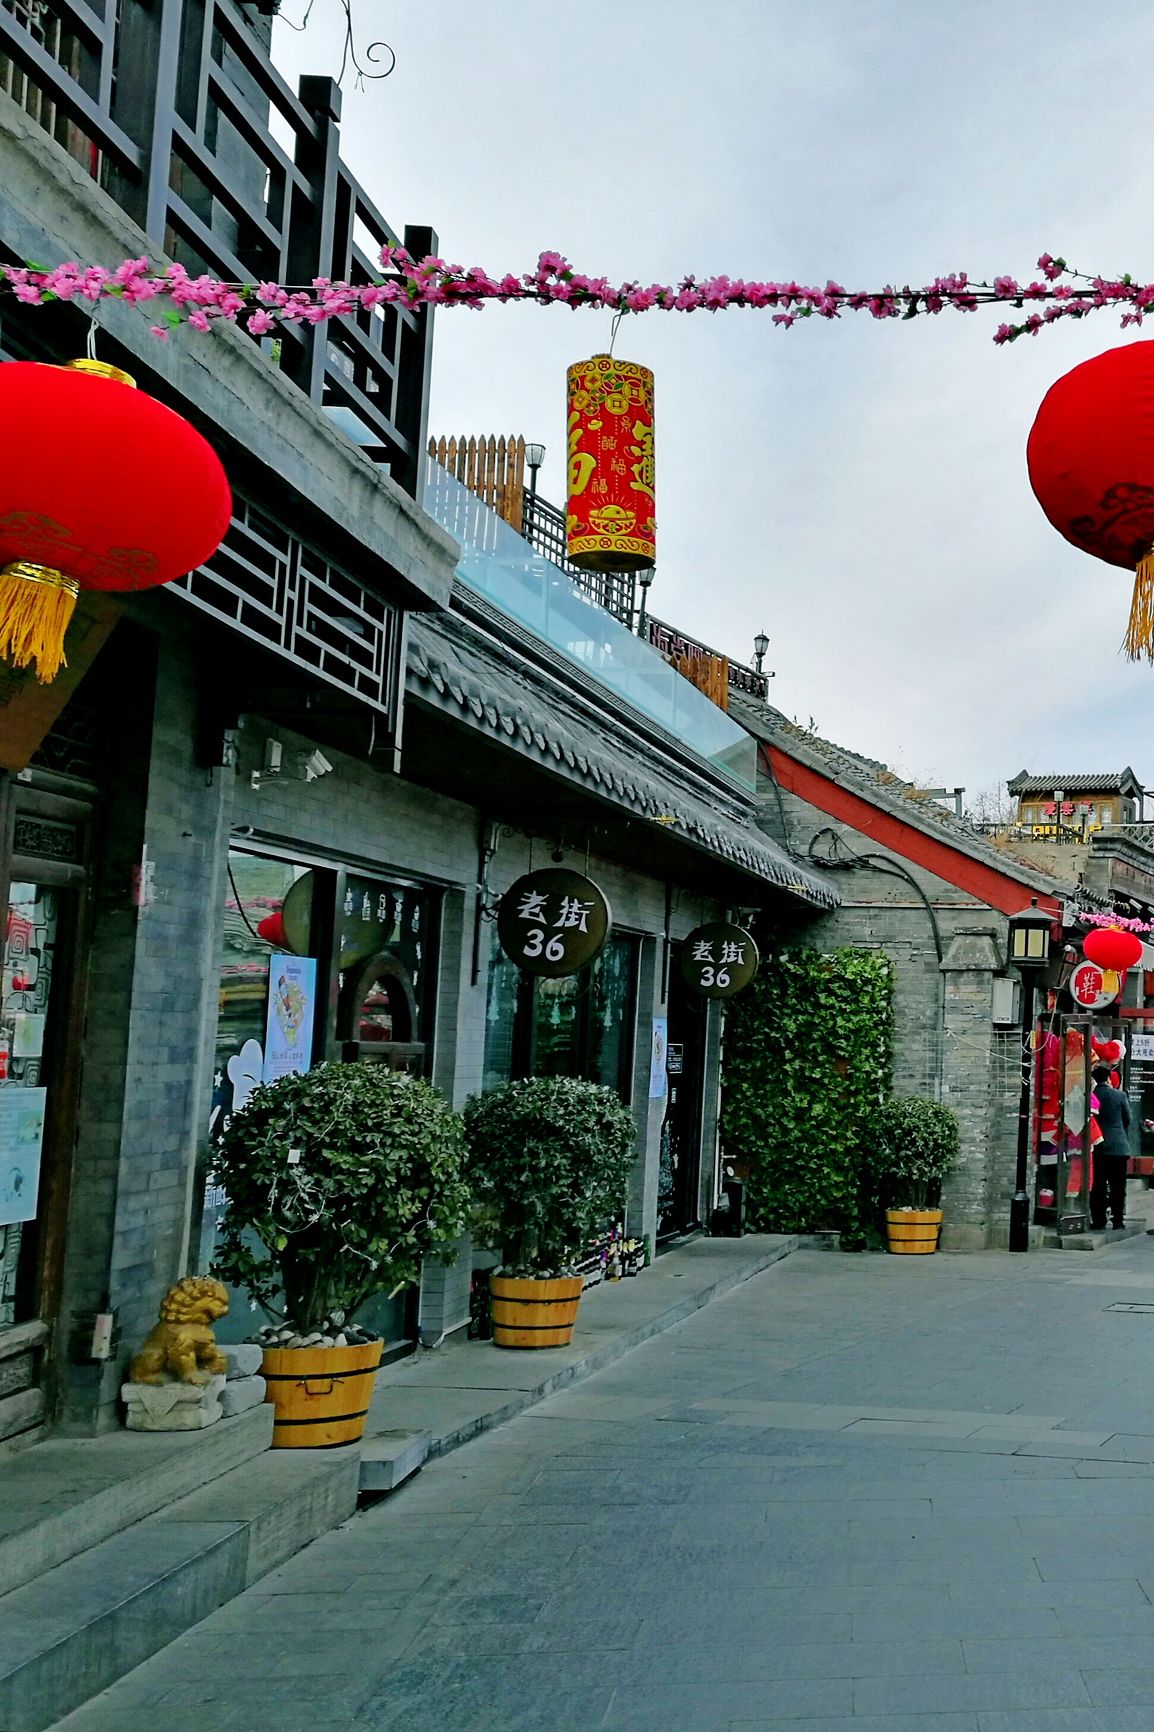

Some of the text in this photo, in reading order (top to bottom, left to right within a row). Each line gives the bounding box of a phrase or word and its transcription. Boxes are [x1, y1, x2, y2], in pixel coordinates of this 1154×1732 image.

[517, 890, 595, 934] 老街
[522, 929, 565, 962] 36
[691, 939, 746, 965] 老街
[700, 966, 731, 988] 36
